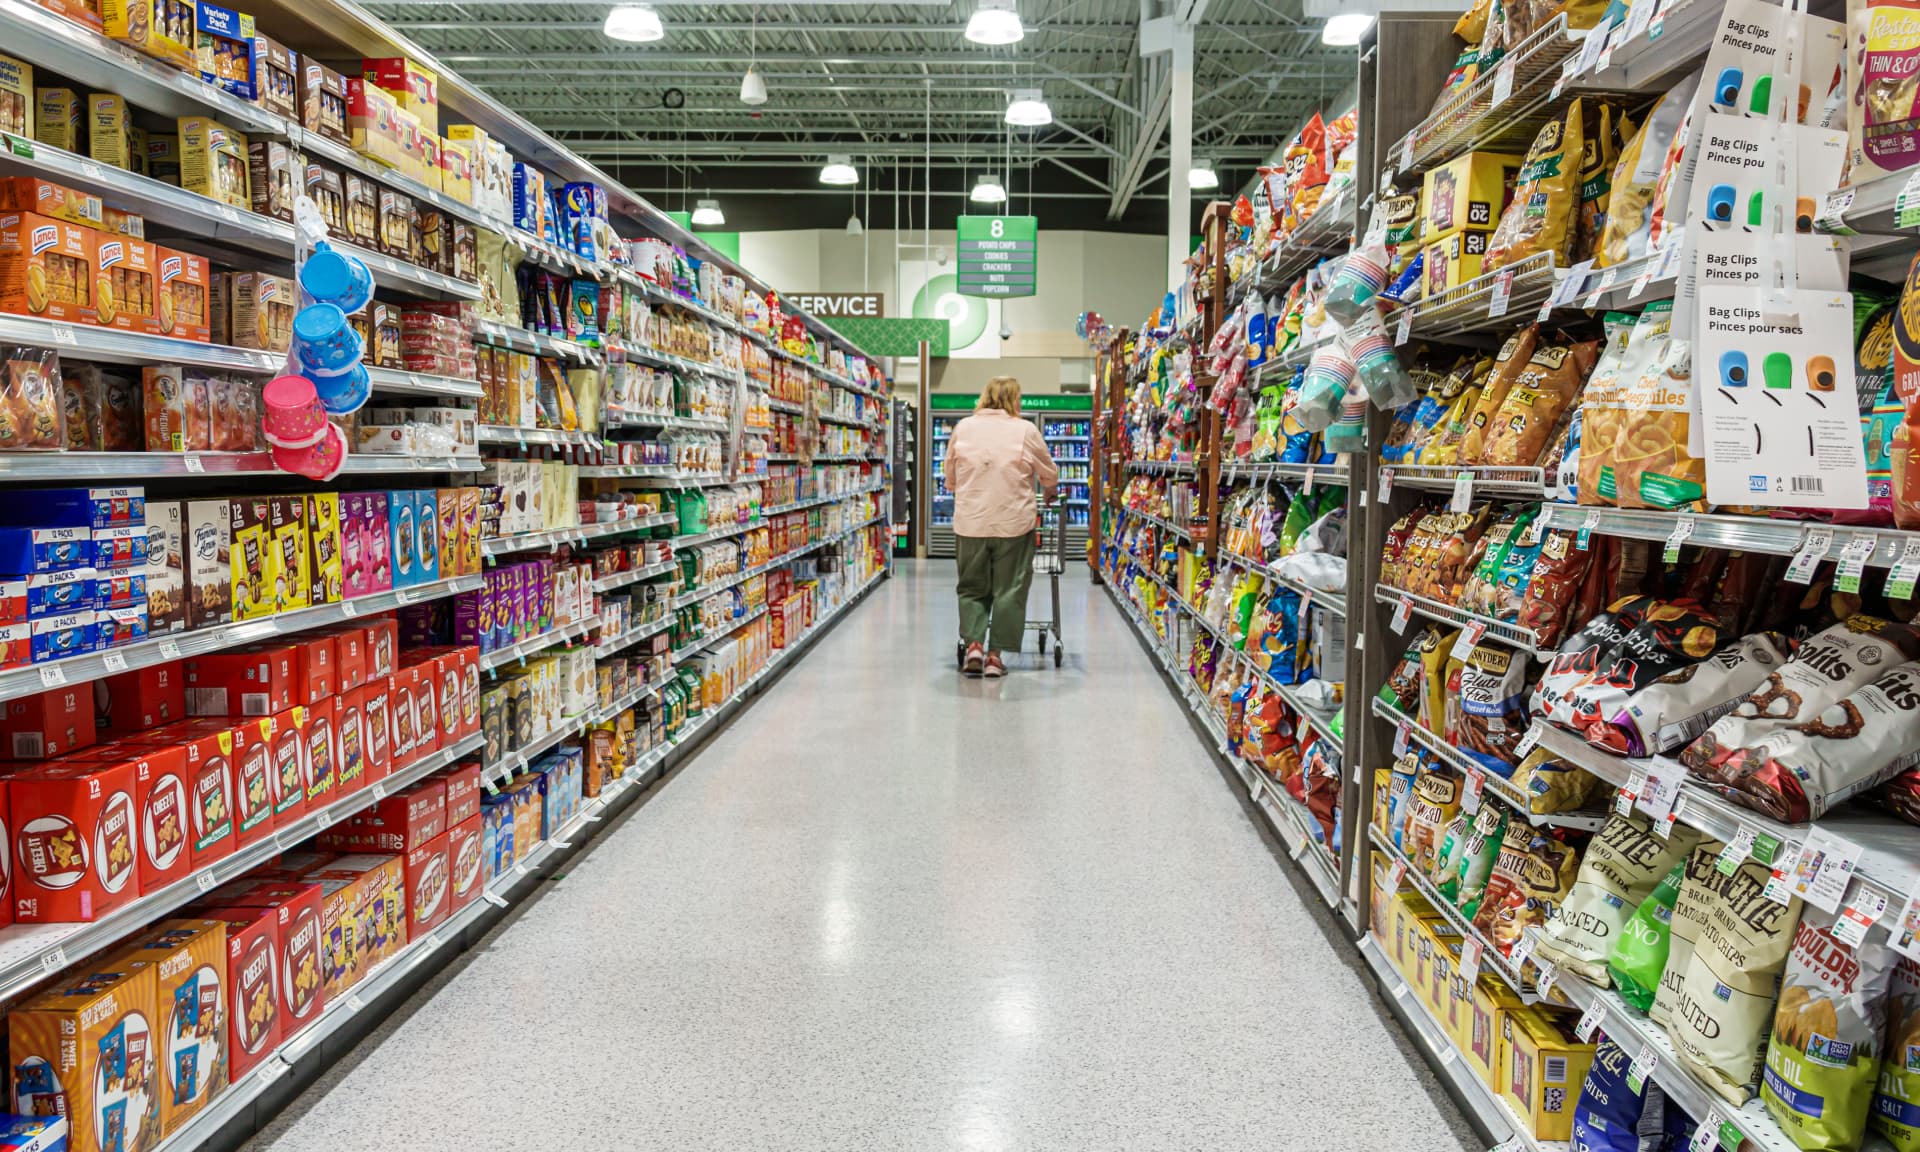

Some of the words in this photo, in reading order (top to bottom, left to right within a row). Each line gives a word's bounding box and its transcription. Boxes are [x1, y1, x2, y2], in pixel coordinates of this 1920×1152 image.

[203, 5, 230, 22] Variety
[208, 16, 228, 29] Pack
[1727, 19, 1744, 34] Bag
[1746, 21, 1770, 39] Clips
[1722, 34, 1753, 51] Pinces
[1753, 43, 1777, 57] pour
[1889, 36, 1920, 50] STY
[1870, 55, 1891, 74] THIN
[1892, 56, 1903, 74] &
[1710, 136, 1729, 151] Bag
[1732, 139, 1759, 152] Clips
[1872, 144, 1880, 156] 4
[1707, 151, 1741, 166] Pinces
[1743, 157, 1765, 168] pou
[1470, 210, 1489, 222] 20
[65, 226, 81, 240] Toast
[990, 219, 1004, 238] 8
[34, 231, 57, 247] Lance
[66, 239, 82, 252] Chee
[978, 241, 998, 250] POTATO
[999, 241, 1016, 250] CHIPS
[1466, 234, 1478, 253] 20
[101, 247, 122, 263] Lance
[129, 242, 144, 254] Toast
[131, 253, 145, 264] Chee
[186, 256, 199, 269] Toast
[984, 252, 1008, 260] COOKIES
[1706, 254, 1728, 266] Bag
[1730, 254, 1758, 266] Clips
[162, 262, 181, 276] Lance
[982, 262, 1011, 272] CRACKERS
[989, 274, 1004, 282] NUTS
[1705, 268, 1742, 280] Pinces
[1744, 271, 1760, 282] po
[982, 284, 1010, 293] POPCORN
[1709, 306, 1730, 320] Bag
[1732, 307, 1761, 320] Clips
[1709, 320, 1746, 333] Pinces
[1749, 324, 1776, 335] pour
[1778, 324, 1804, 335] sacs
[1902, 374, 1920, 392] GRAI
[1021, 399, 1050, 407] RAGES
[160, 406, 170, 442] CHEDDAR
[219, 505, 228, 517] 10
[272, 503, 281, 517] 12
[365, 498, 372, 510] 12
[168, 507, 178, 519] 10
[232, 504, 243, 519] 12
[52, 529, 57, 538] 12
[58, 529, 74, 537] PACKS
[118, 529, 130, 537] PACKS
[194, 526, 218, 545] Famous
[1808, 536, 1825, 546] 5.49
[48, 574, 54, 584] 12
[55, 571, 76, 582] PACKS
[110, 569, 114, 577] 12
[115, 568, 129, 576] PACKS
[53, 619, 59, 628] 12
[60, 616, 77, 627] PACKS
[0, 628, 10, 640] CKS
[1799, 640, 1853, 682] plits
[158, 670, 168, 683] 12
[64, 693, 76, 707] 12
[1465, 686, 1495, 704] Free
[235, 731, 244, 743] 12
[189, 744, 198, 757] 12
[278, 739, 295, 761] CHEEZ-IT
[138, 762, 149, 775] 12
[244, 753, 263, 777] CHEEZ-IT
[89, 779, 100, 793] 12
[200, 768, 221, 794] CHEEZ-IT
[153, 791, 175, 816] CHEEZ-IT
[104, 808, 126, 836] CHEEZ-IT
[393, 834, 404, 849] 20
[28, 837, 48, 874] CHEEZ-IT
[1687, 887, 1714, 907] BRAN
[19, 898, 31, 917] 12
[279, 907, 289, 920] 20
[1713, 905, 1737, 932] BRAND
[231, 938, 241, 951] 20
[289, 920, 314, 957] CHEEZ-IT
[1717, 934, 1748, 969] CHIPS
[44, 953, 58, 966] 9.49
[160, 961, 170, 974] 20
[172, 949, 190, 966] SWEET
[177, 957, 193, 973] SALTY
[242, 950, 267, 989] CHEEZ-IT
[202, 990, 216, 1003] CHEEZ-IT
[80, 1010, 91, 1023] 20
[93, 995, 114, 1013] SWEET
[99, 1004, 118, 1021] SALTY
[66, 1020, 75, 1035] 20
[69, 1037, 77, 1067] SWEET
[129, 1039, 145, 1053] CHEEZ-IT
[1830, 1047, 1850, 1057] GMO
[1831, 1040, 1851, 1051] NON
[61, 1047, 69, 1073] SALTY
[1783, 1060, 1804, 1088] OIL
[1774, 1078, 1783, 1096] SEA
[1782, 1084, 1797, 1105] SALT
[1880, 1071, 1911, 1099] OIL
[1881, 1098, 1904, 1118] SALT
[1708, 1111, 1722, 1127] 4.29
[1789, 1112, 1804, 1129] CHIPS
[1575, 1124, 1586, 1138] &
[1890, 1125, 1912, 1141] CHIPS
